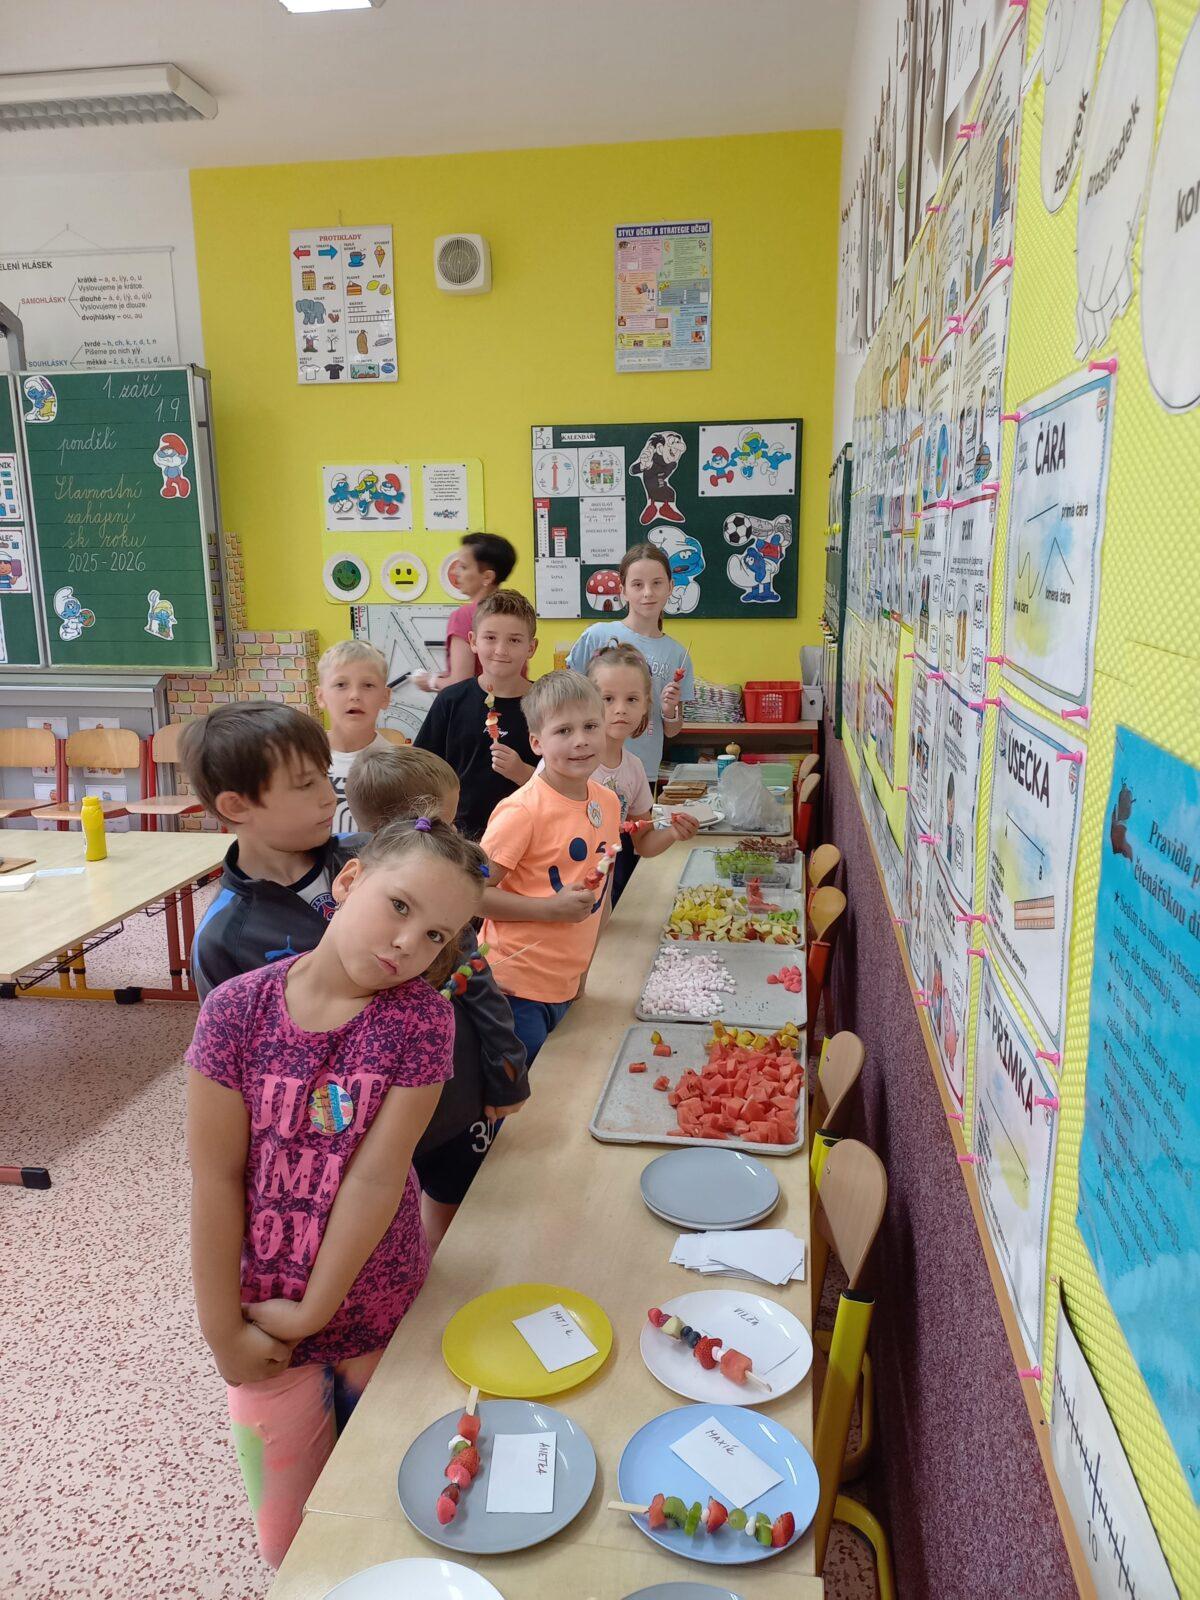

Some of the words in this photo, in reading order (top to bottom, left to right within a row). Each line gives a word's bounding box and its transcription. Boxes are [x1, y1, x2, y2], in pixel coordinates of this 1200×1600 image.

[1054, 88, 1089, 194] začátek
[1085, 95, 1140, 206] prostředek
[319, 234, 361, 242] PROTIKLADY
[618, 229, 635, 237] STYLY
[636, 226, 653, 236] UČENÍ
[660, 226, 690, 235] STRATEGIE
[691, 223, 709, 233] UČENÍ
[22, 260, 53, 270] HLÁSEK
[21, 296, 66, 305] SAMOHLÁSKY
[81, 313, 115, 322] dvojhlásky
[28, 358, 68, 368] SOUHLÁSKY
[118, 373, 162, 399] září
[1035, 420, 1066, 476] ČÁRA
[55, 473, 143, 500] Slavnostní
[63, 500, 135, 538] zahájení
[99, 523, 147, 548] roku
[1007, 729, 1050, 809] ÚSEČKA
[1148, 820, 1192, 875] Pravidla
[1134, 855, 1186, 926] čtenářskou
[1139, 917, 1147, 937] na
[1147, 929, 1167, 959] mnou
[1131, 944, 1140, 966] ale
[1124, 968, 1133, 992] 20
[991, 1003, 1033, 1126] PŘÍMKA
[252, 1073, 388, 1139] JUT
